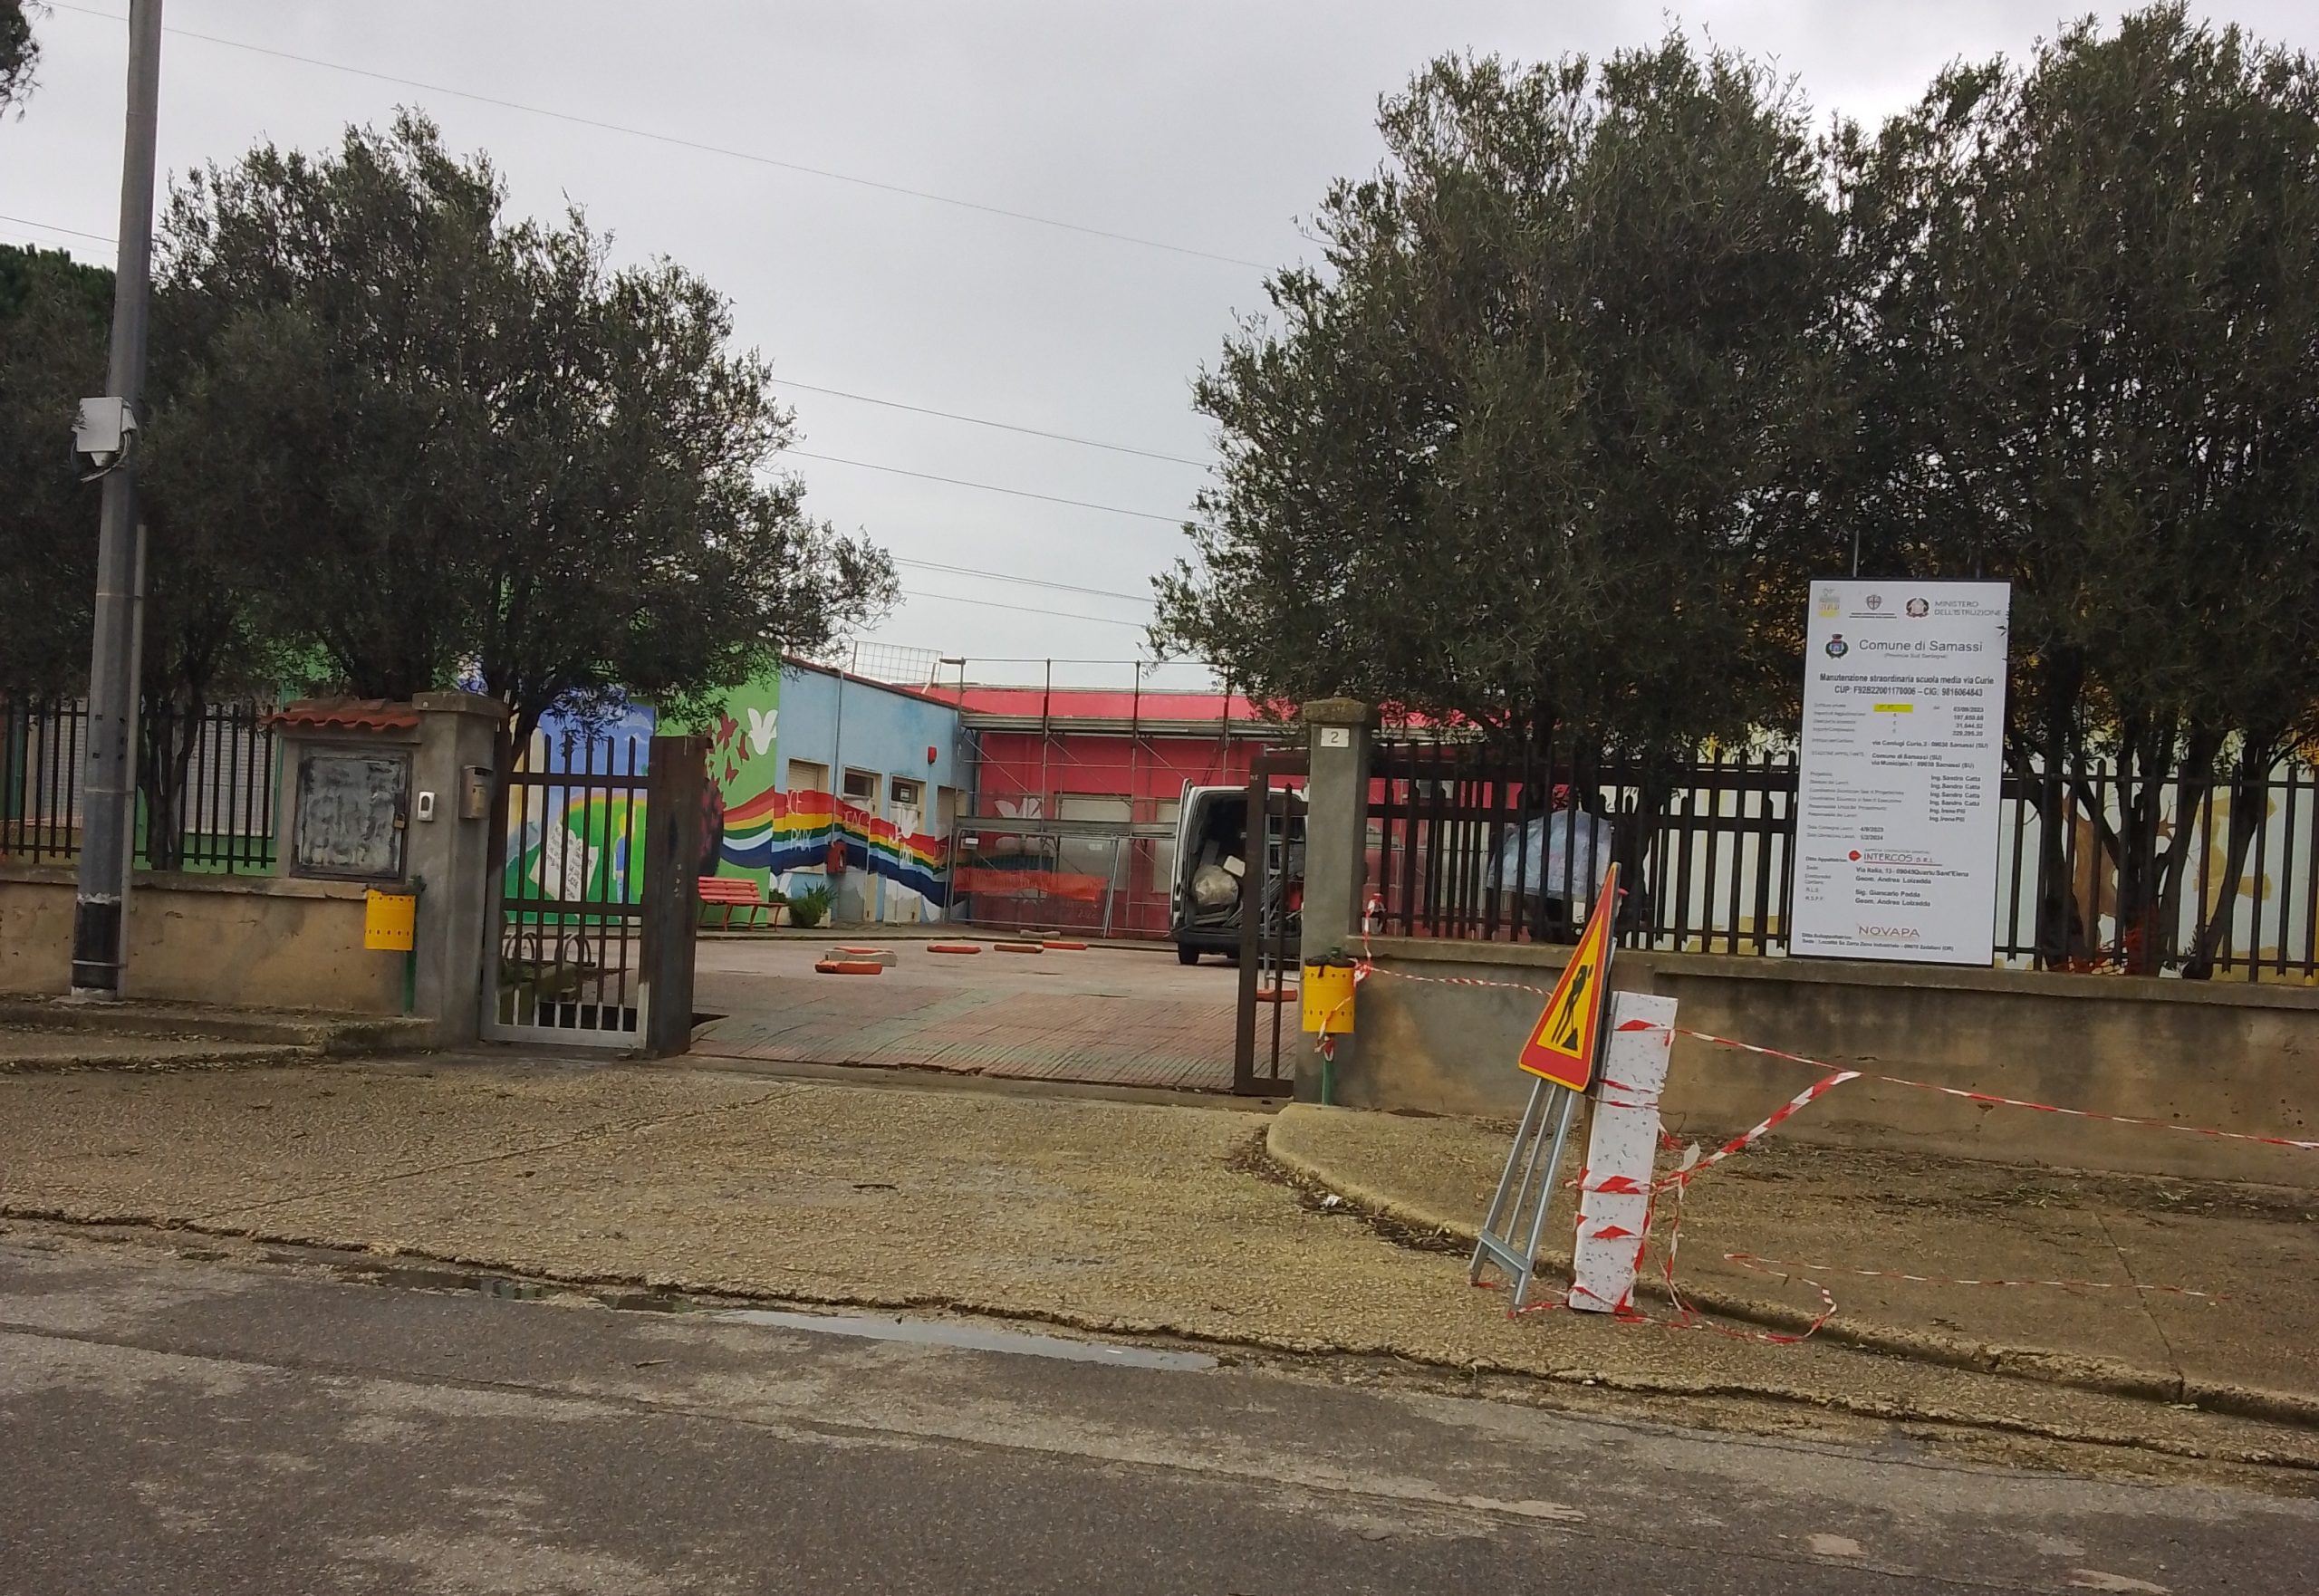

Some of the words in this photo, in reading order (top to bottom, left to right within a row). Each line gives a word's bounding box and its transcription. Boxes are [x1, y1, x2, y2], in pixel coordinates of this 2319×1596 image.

[1859, 639, 1911, 651] Comune
[1914, 639, 1926, 651] di
[1929, 639, 1983, 652] Samassi
[1819, 673, 1868, 682] Manutenzione
[1870, 674, 1914, 683] straordinaria
[1916, 676, 1939, 684] scuola
[1940, 676, 1962, 684] media
[1975, 676, 1994, 685] Curie
[1331, 731, 1339, 744] 2
[1863, 852, 1913, 862] INTERCOS
[1859, 926, 1920, 937] NOVAPA
